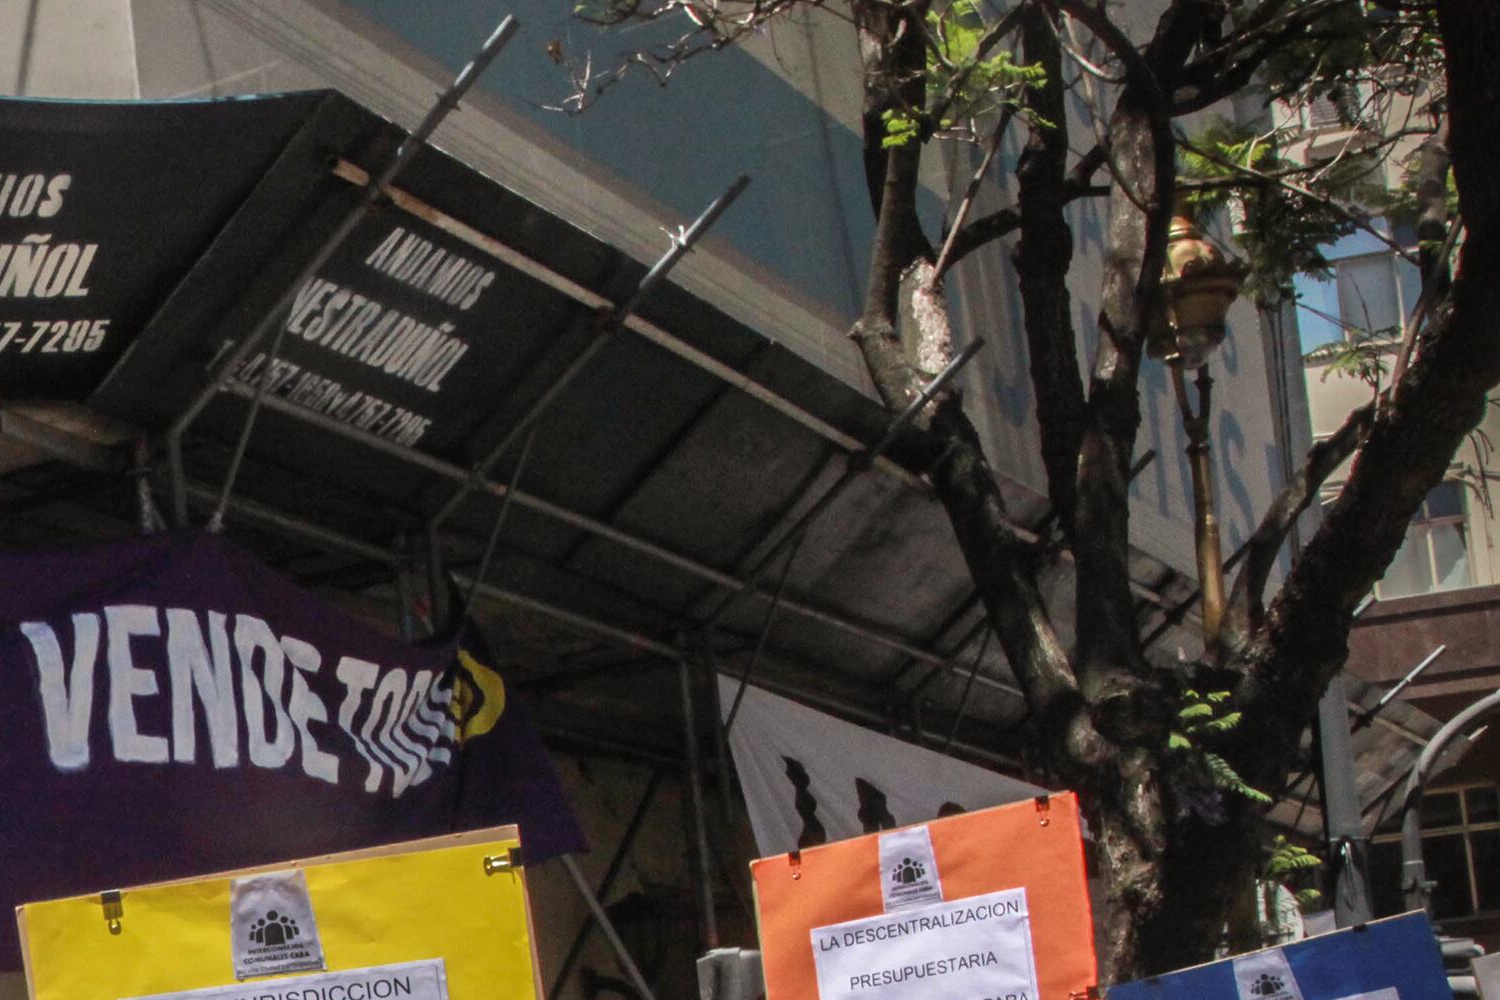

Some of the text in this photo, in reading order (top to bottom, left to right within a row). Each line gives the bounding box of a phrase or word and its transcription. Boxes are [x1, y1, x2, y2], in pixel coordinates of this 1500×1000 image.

[365, 226, 496, 311] ANDAMIOS
[20, 604, 340, 785] VENDE
[820, 899, 1019, 951] LA DESCENTRALIZACION
[850, 951, 998, 990] PRESUPUESTARIA
